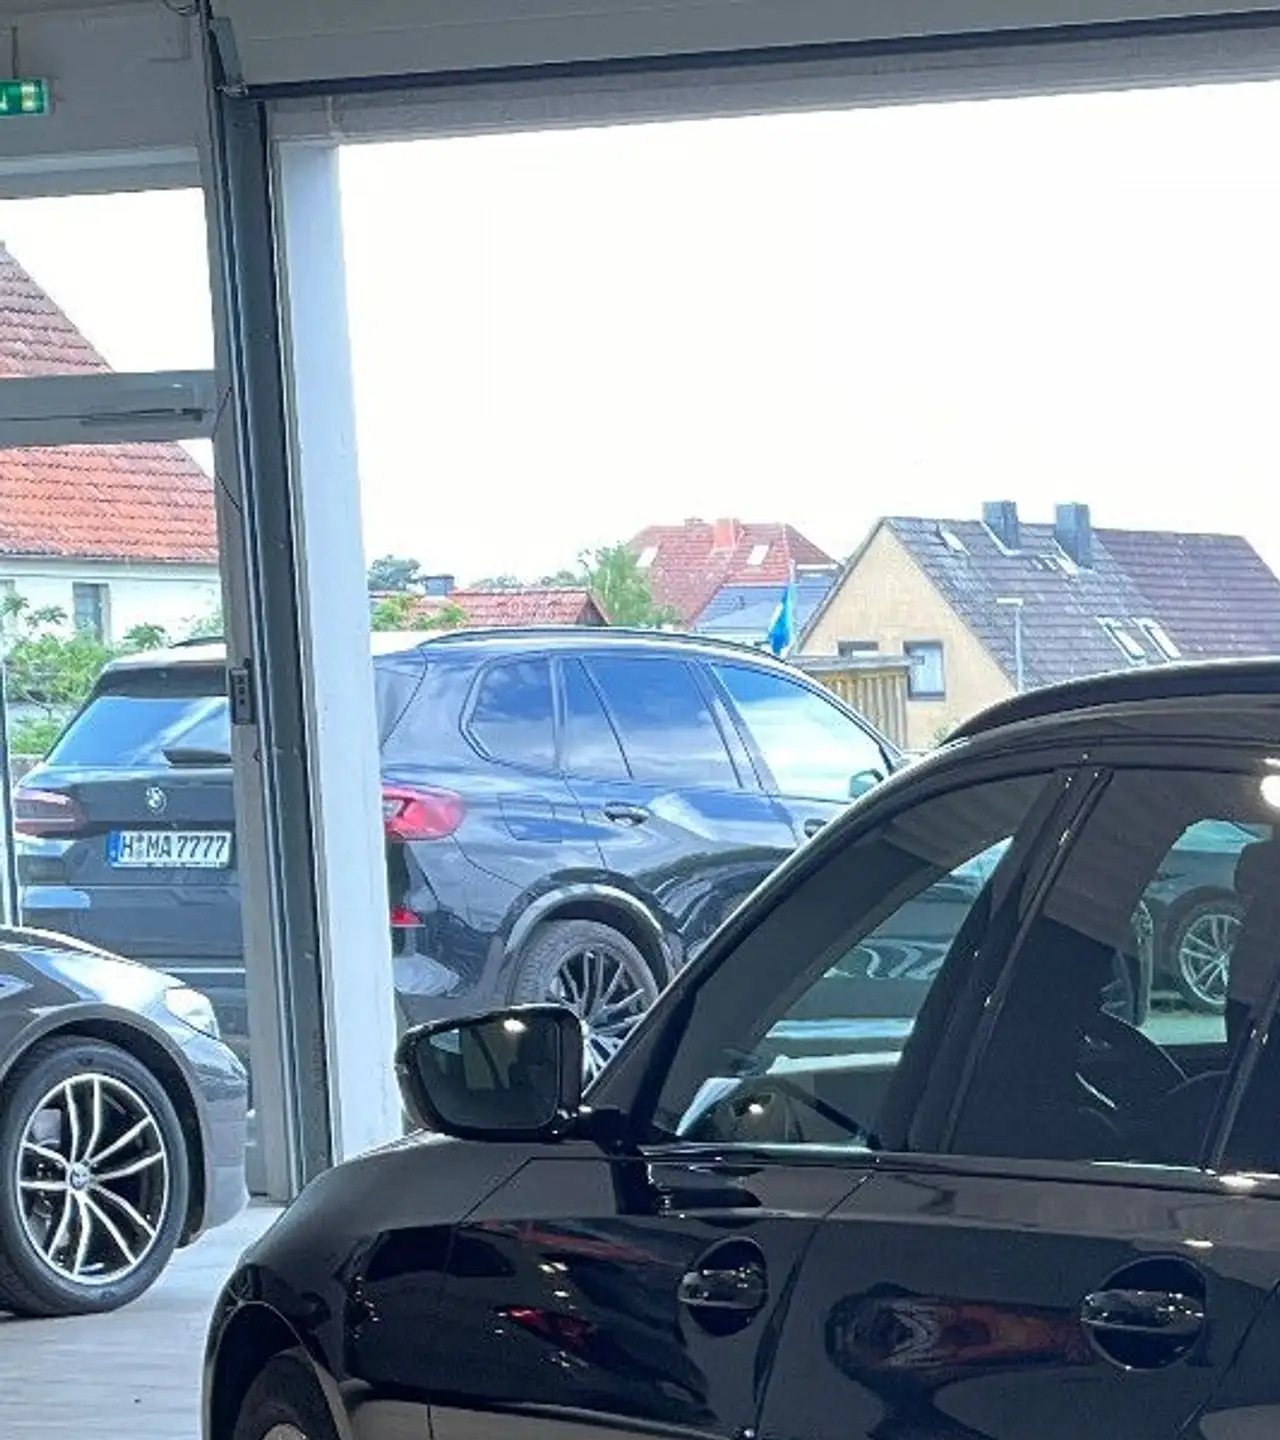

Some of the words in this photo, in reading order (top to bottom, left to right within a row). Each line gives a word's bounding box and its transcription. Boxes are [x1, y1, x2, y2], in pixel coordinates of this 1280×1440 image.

[120, 835, 133, 858] H
[146, 834, 172, 858] MA
[177, 834, 228, 858] 7777
